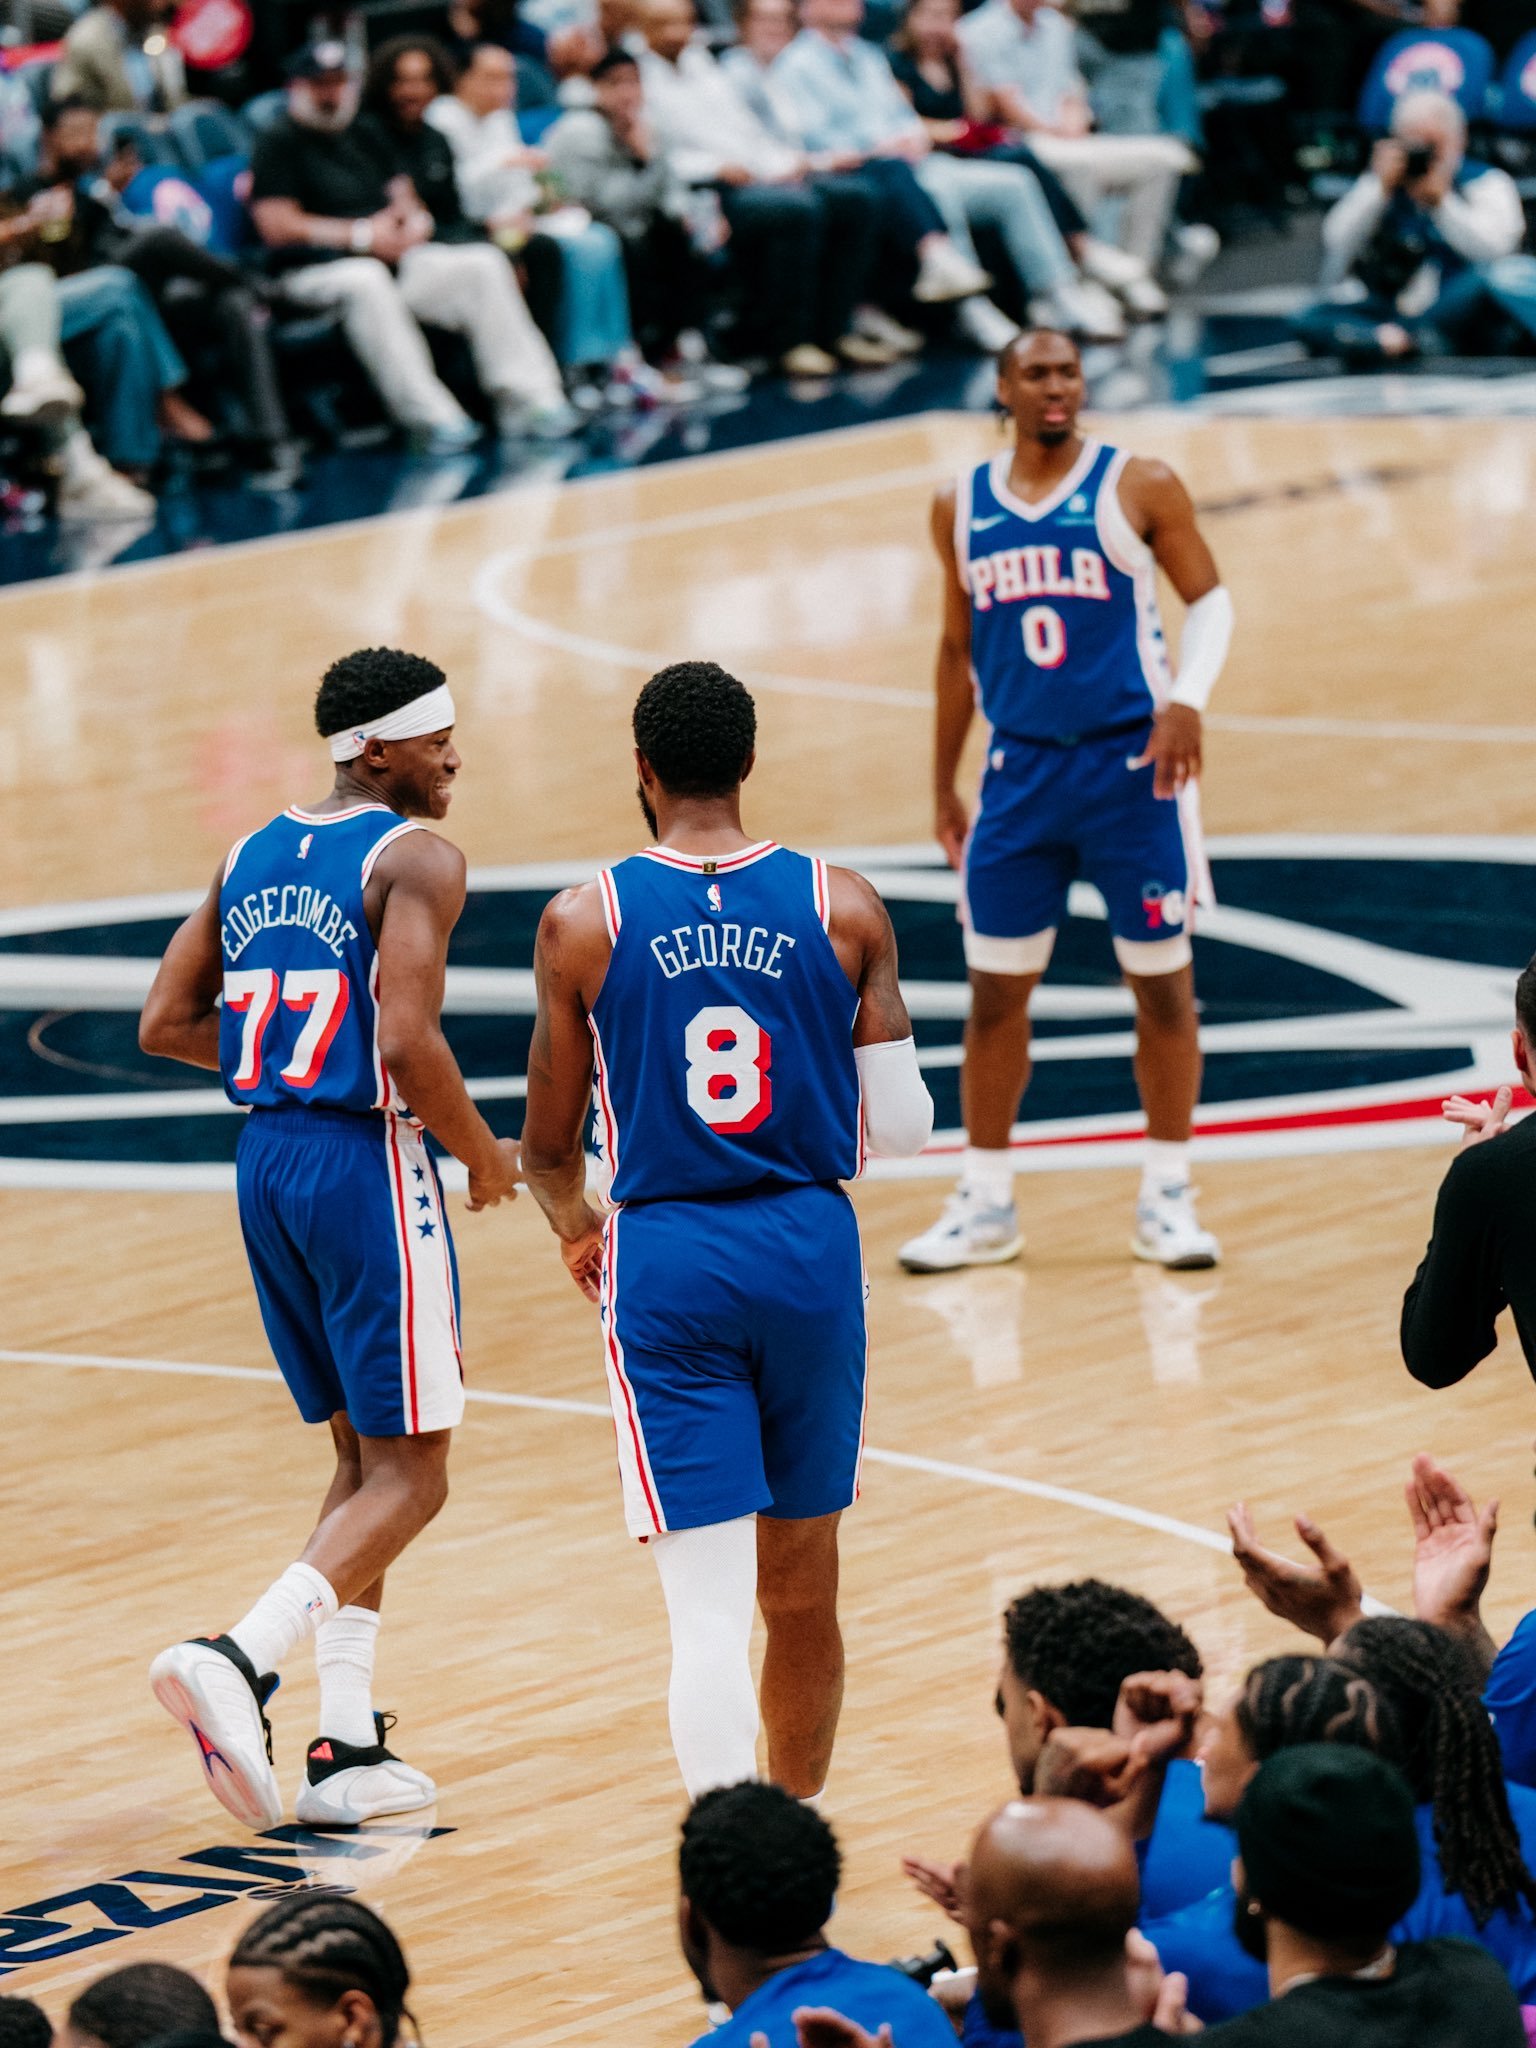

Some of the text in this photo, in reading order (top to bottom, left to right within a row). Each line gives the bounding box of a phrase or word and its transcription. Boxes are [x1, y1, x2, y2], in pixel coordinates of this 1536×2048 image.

[970, 545, 1111, 610] PHILA
[1021, 604, 1067, 669] 0
[221, 885, 358, 962] EDGECOMBE
[650, 923, 796, 979] GEORGE
[223, 968, 350, 1090] 77
[684, 1005, 772, 1134] 8
